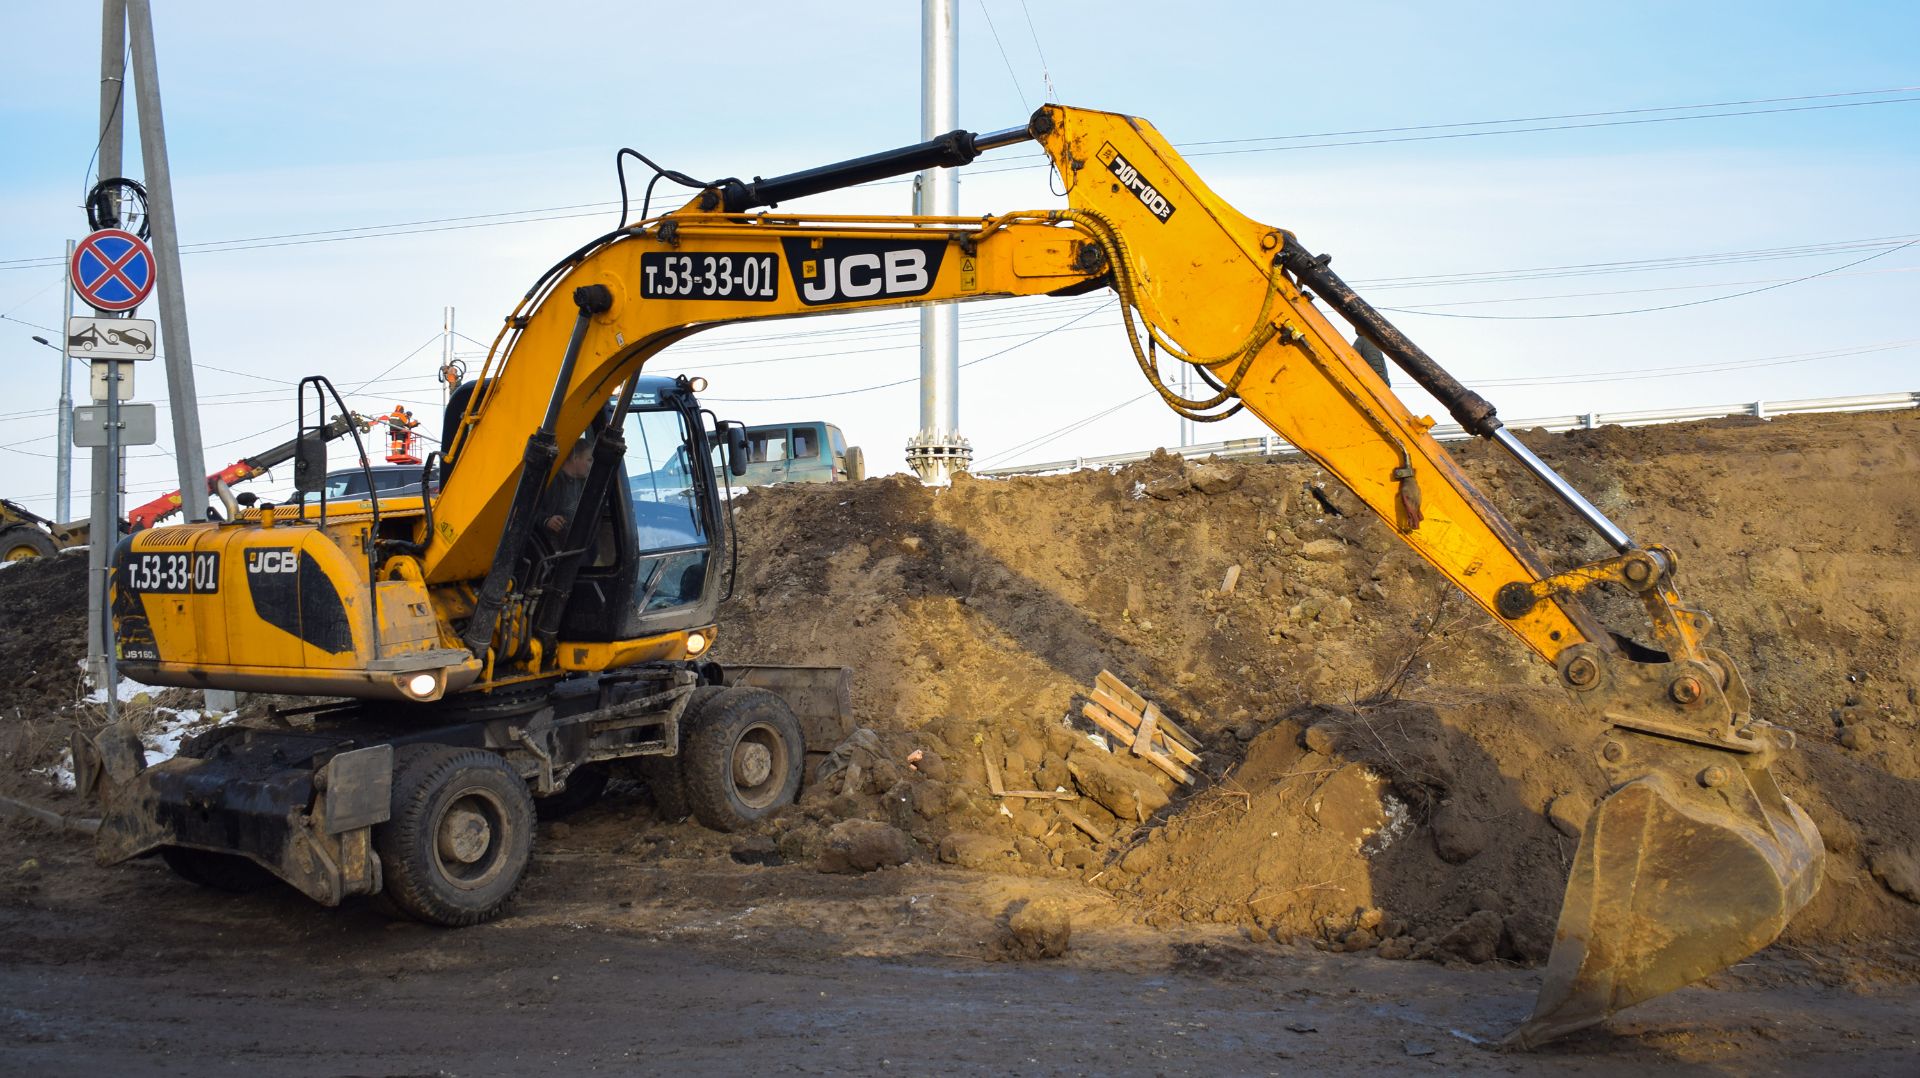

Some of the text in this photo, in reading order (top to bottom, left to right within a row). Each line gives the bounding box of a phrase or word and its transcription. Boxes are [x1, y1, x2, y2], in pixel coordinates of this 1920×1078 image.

[645, 256, 774, 297] т.53-33-01
[803, 248, 929, 302] JCB
[128, 554, 216, 590] т.53-33-01
[249, 551, 298, 574] JCB
